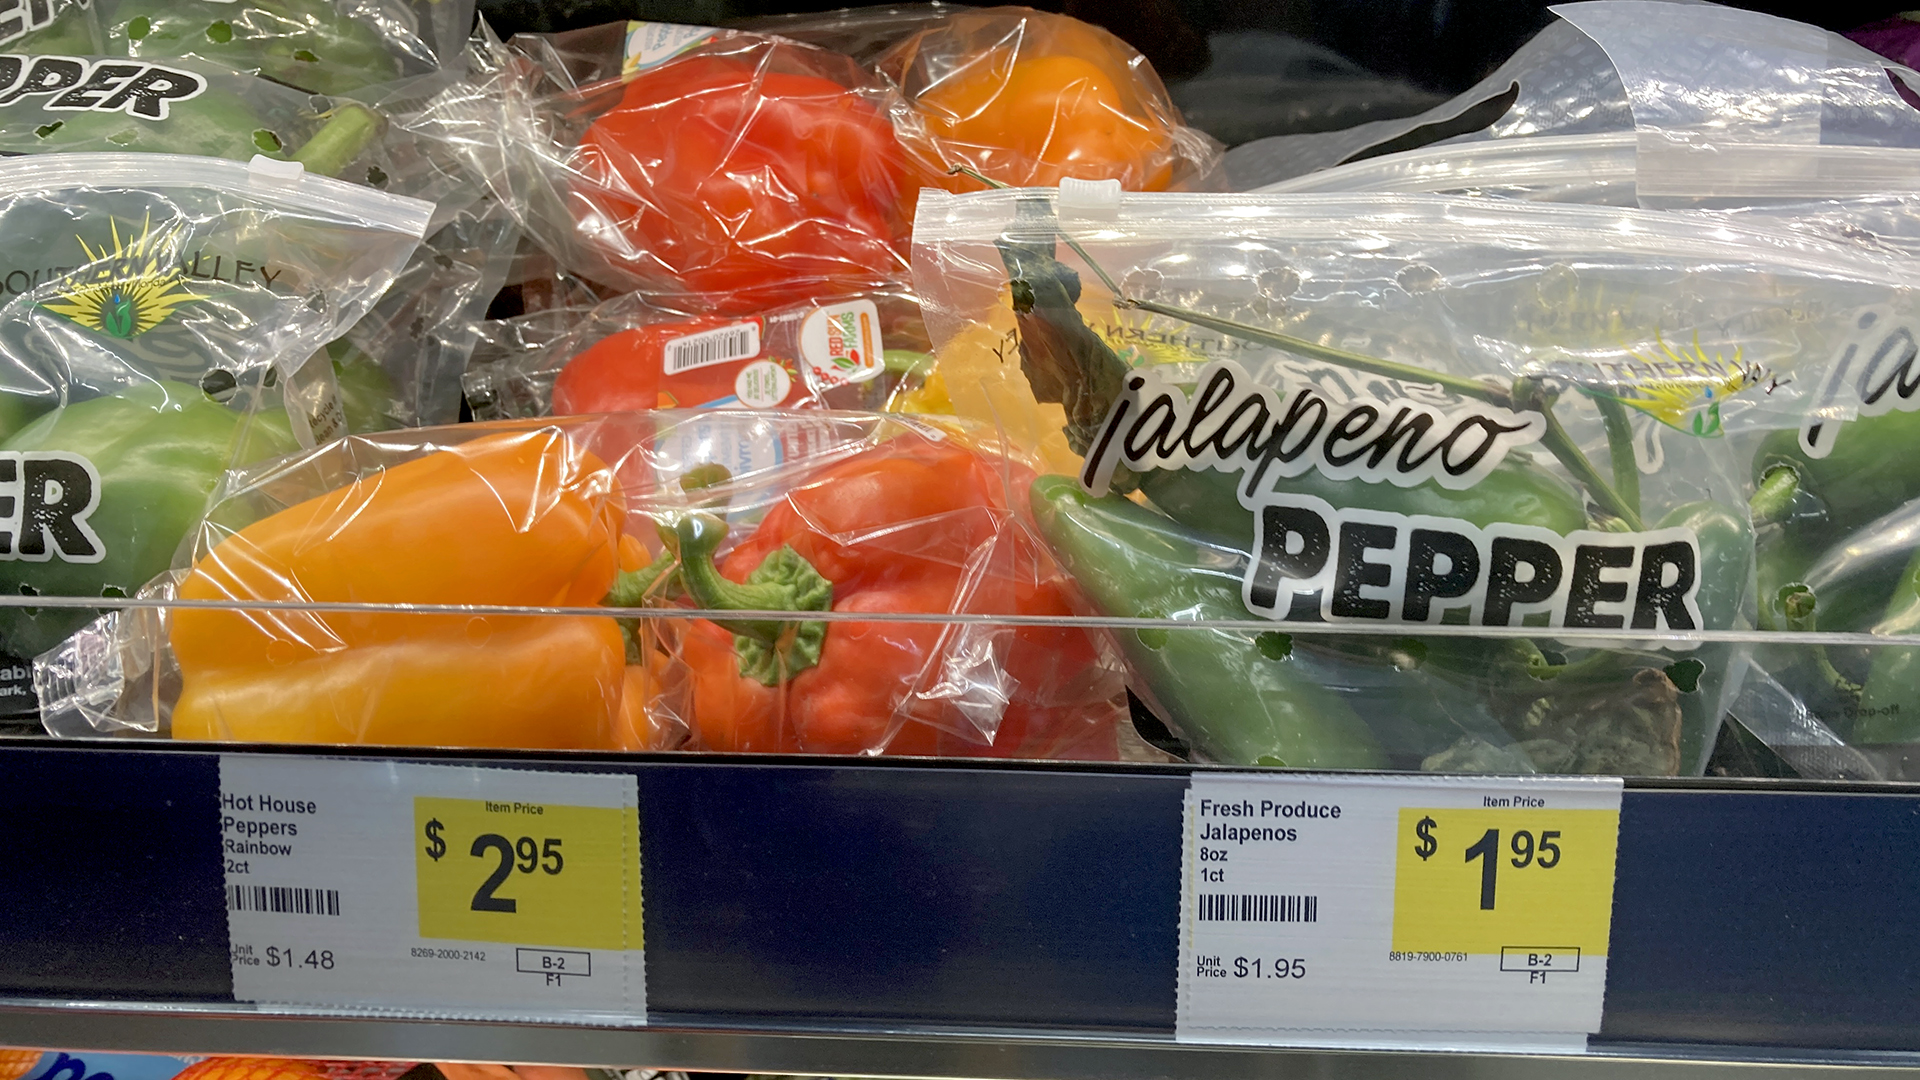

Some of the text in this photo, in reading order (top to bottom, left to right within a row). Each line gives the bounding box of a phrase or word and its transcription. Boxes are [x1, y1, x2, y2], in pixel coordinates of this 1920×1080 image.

[156, 251, 282, 289] VALLEY
[842, 311, 857, 349] FARMS
[829, 337, 843, 357] RED
[1084, 368, 1532, 498] jalapeno
[1250, 504, 1698, 632] PEPPER
[222, 793, 317, 814] Hot House
[485, 801, 544, 816] Item Price
[1199, 799, 1342, 819] Fresh Produce
[1483, 796, 1545, 808] Item Price
[223, 816, 298, 838] Peppers
[1199, 823, 1298, 845] Jalapenos
[225, 839, 292, 856] Rainbow
[1199, 847, 1229, 863] 8oz
[226, 858, 251, 874] 2ct
[1200, 868, 1225, 883] 1ct
[265, 945, 335, 970] $1.48
[410, 947, 486, 962] 8269-2000-2142
[542, 955, 566, 970] B-2
[1196, 955, 1221, 967] Unit
[1388, 951, 1469, 963] 8819-7900-0761
[1528, 954, 1552, 967] B-2
[1196, 967, 1228, 978] Price
[1233, 956, 1306, 980] $1.95
[545, 974, 562, 987] F1
[1530, 972, 1547, 985] F1
